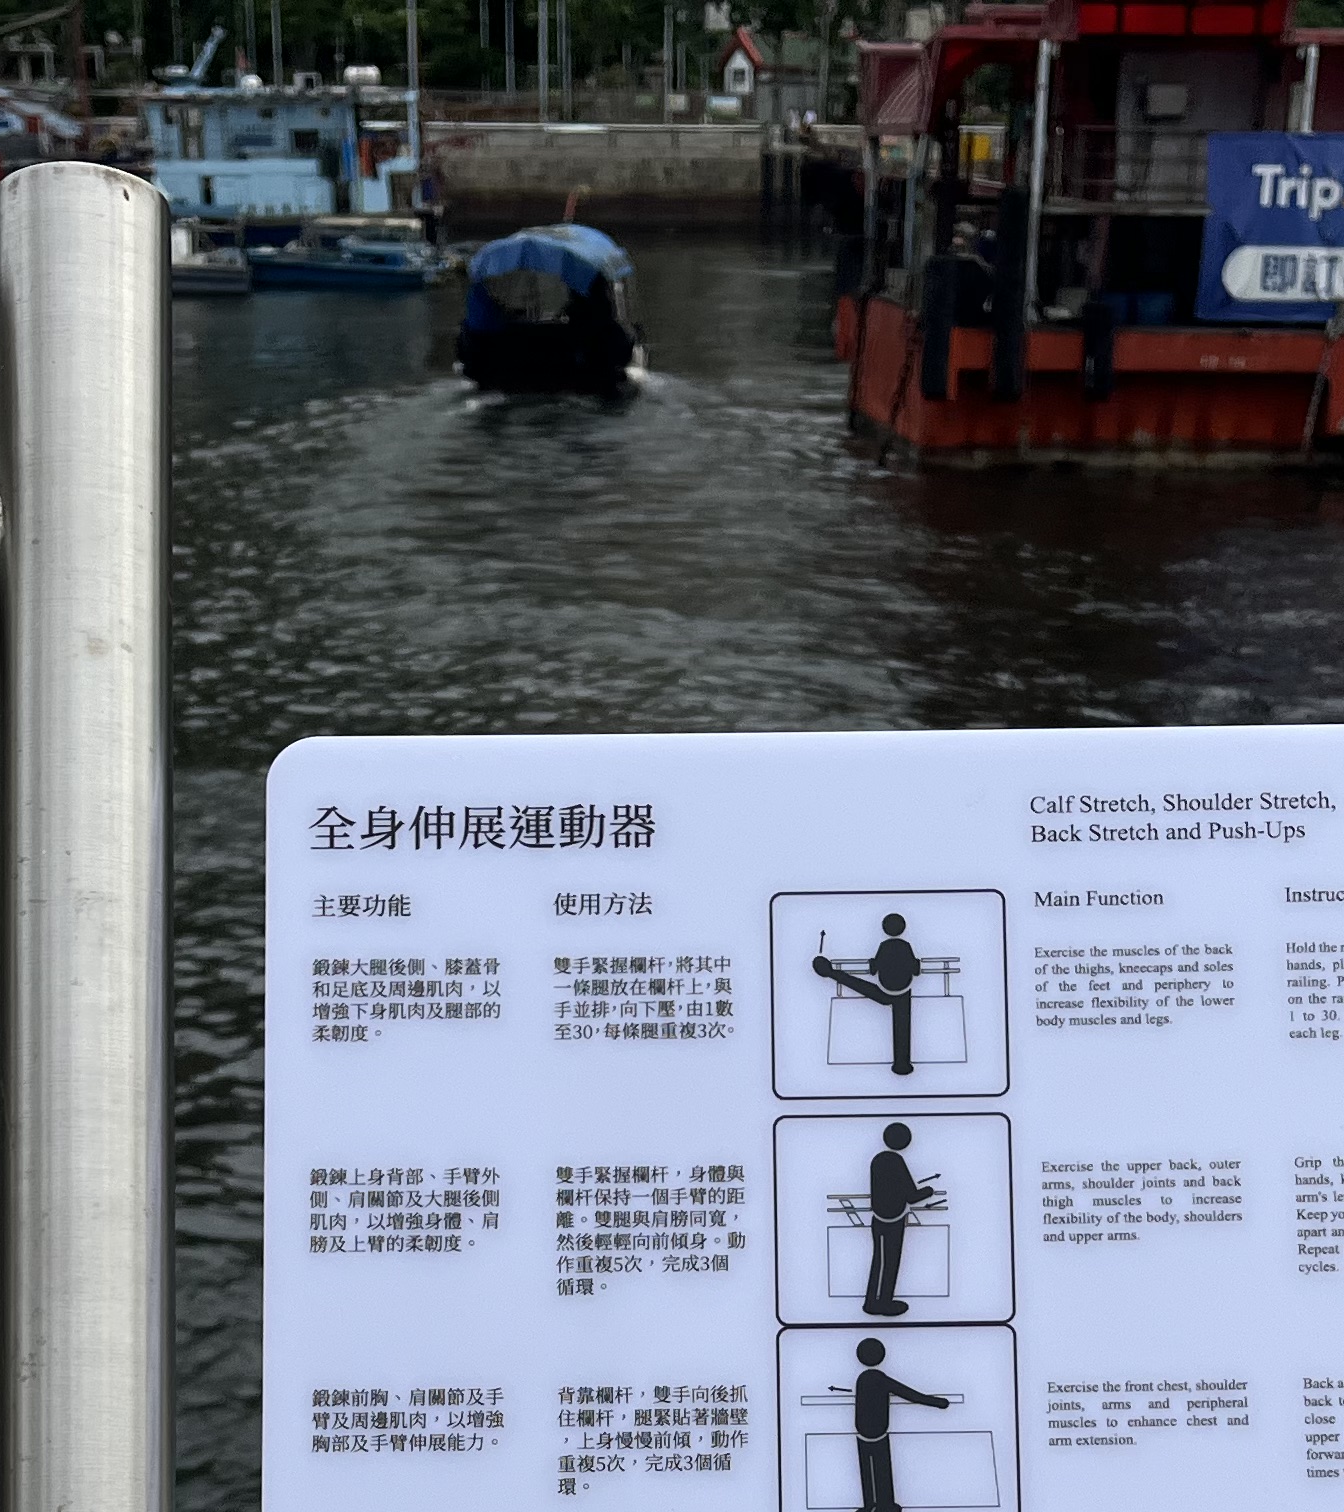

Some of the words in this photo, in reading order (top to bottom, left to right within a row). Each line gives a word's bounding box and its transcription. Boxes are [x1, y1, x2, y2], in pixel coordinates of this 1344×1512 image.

[1029, 794, 1076, 815] Calf
[1079, 793, 1156, 816] Stretch,
[1162, 792, 1254, 812] Shoulder
[1259, 790, 1337, 813] Stretch,
[308, 803, 656, 851] 全身伸展運動器
[1030, 823, 1083, 843] Back
[1088, 822, 1160, 842] Stretch
[1165, 821, 1202, 841] and
[1207, 820, 1306, 844] Push-Ups
[311, 893, 412, 918] 主要功能
[552, 891, 653, 917] 使用方法
[1033, 890, 1081, 908] Main
[1085, 889, 1164, 907] Function
[1034, 945, 1086, 959] Exercise
[1089, 945, 1108, 958] the
[1111, 944, 1161, 957] muscles
[1164, 943, 1180, 957] of
[1181, 943, 1201, 956] the
[1203, 943, 1234, 955] back
[1286, 975, 1331, 990] railing.
[1041, 1161, 1094, 1173] Exercise
[1100, 1159, 1120, 1172] the
[1126, 1161, 1163, 1175] upper
[1168, 1158, 1203, 1172] back,
[1208, 1159, 1242, 1170] outer
[1293, 1156, 1323, 1171] Grip
[1045, 1399, 1086, 1415] joints,
[1101, 1401, 1132, 1411] arms
[1147, 1396, 1171, 1410] and
[1186, 1395, 1249, 1412] peripheral
[1047, 1415, 1097, 1429] muscles
[1106, 1417, 1119, 1428] to
[1127, 1415, 1178, 1428] enhance
[1186, 1414, 1218, 1427] chest
[1226, 1413, 1250, 1427] and
[1304, 1412, 1336, 1425] close
